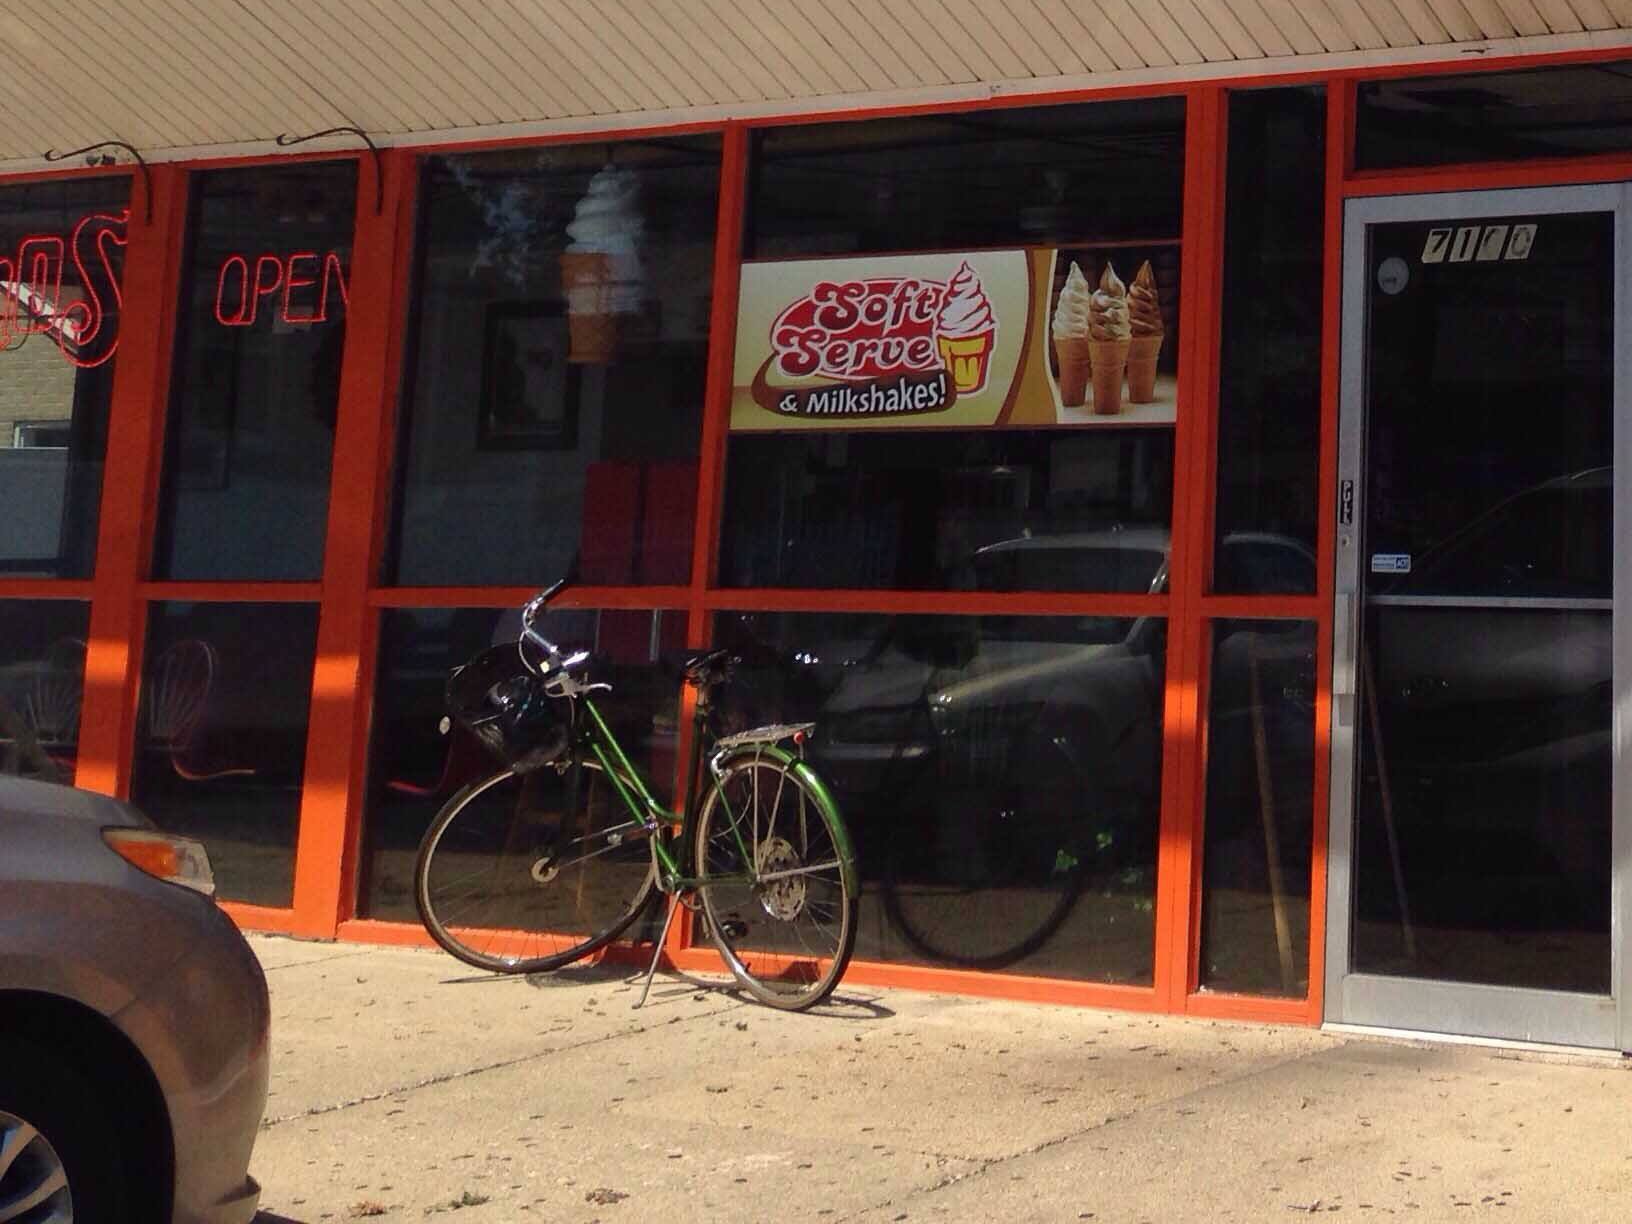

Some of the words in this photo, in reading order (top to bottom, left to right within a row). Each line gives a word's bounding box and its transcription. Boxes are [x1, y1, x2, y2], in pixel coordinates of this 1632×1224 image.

[0, 209, 130, 368] OS
[814, 280, 942, 333] Soft
[776, 327, 933, 377] Serve
[779, 393, 799, 413] &
[806, 374, 946, 414] Milkshakes!
